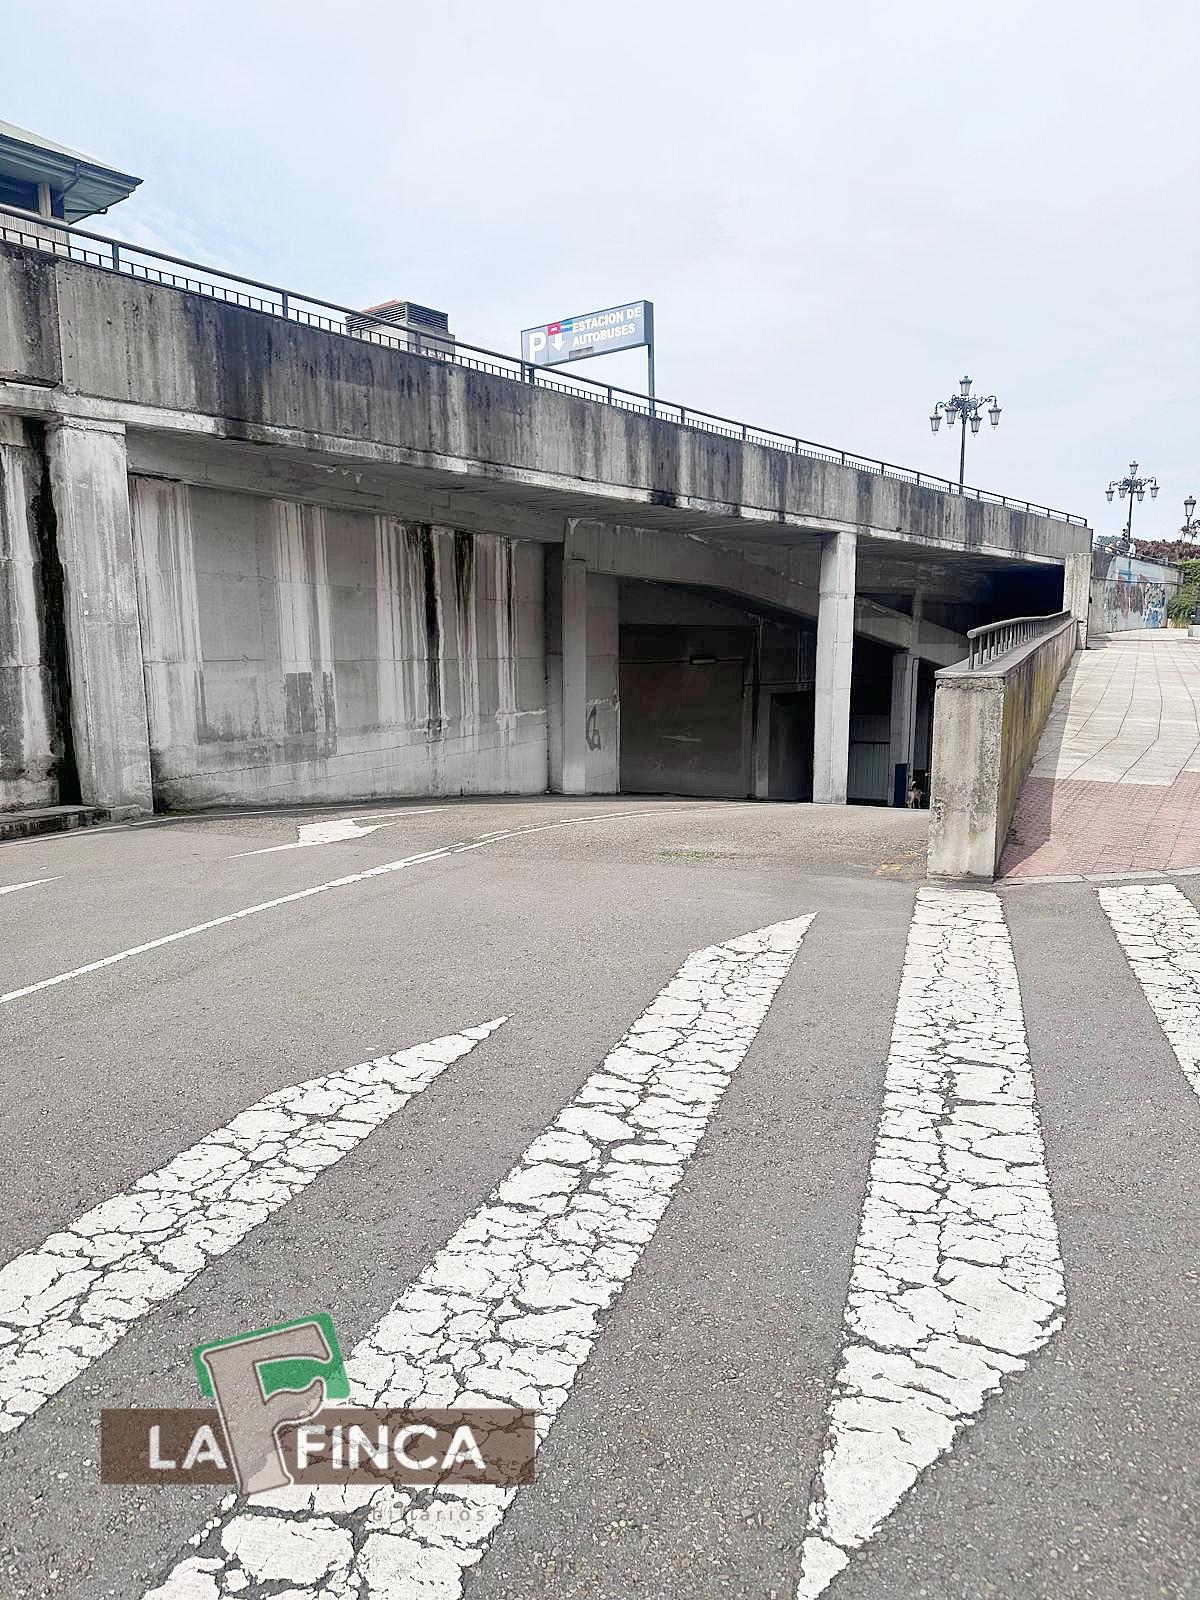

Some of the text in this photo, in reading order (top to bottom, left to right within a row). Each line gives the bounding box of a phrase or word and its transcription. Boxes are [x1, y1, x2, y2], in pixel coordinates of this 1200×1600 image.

[572, 307, 642, 333] ESTACION DE
[529, 331, 547, 363] P
[572, 323, 636, 347] AUTOBUSES
